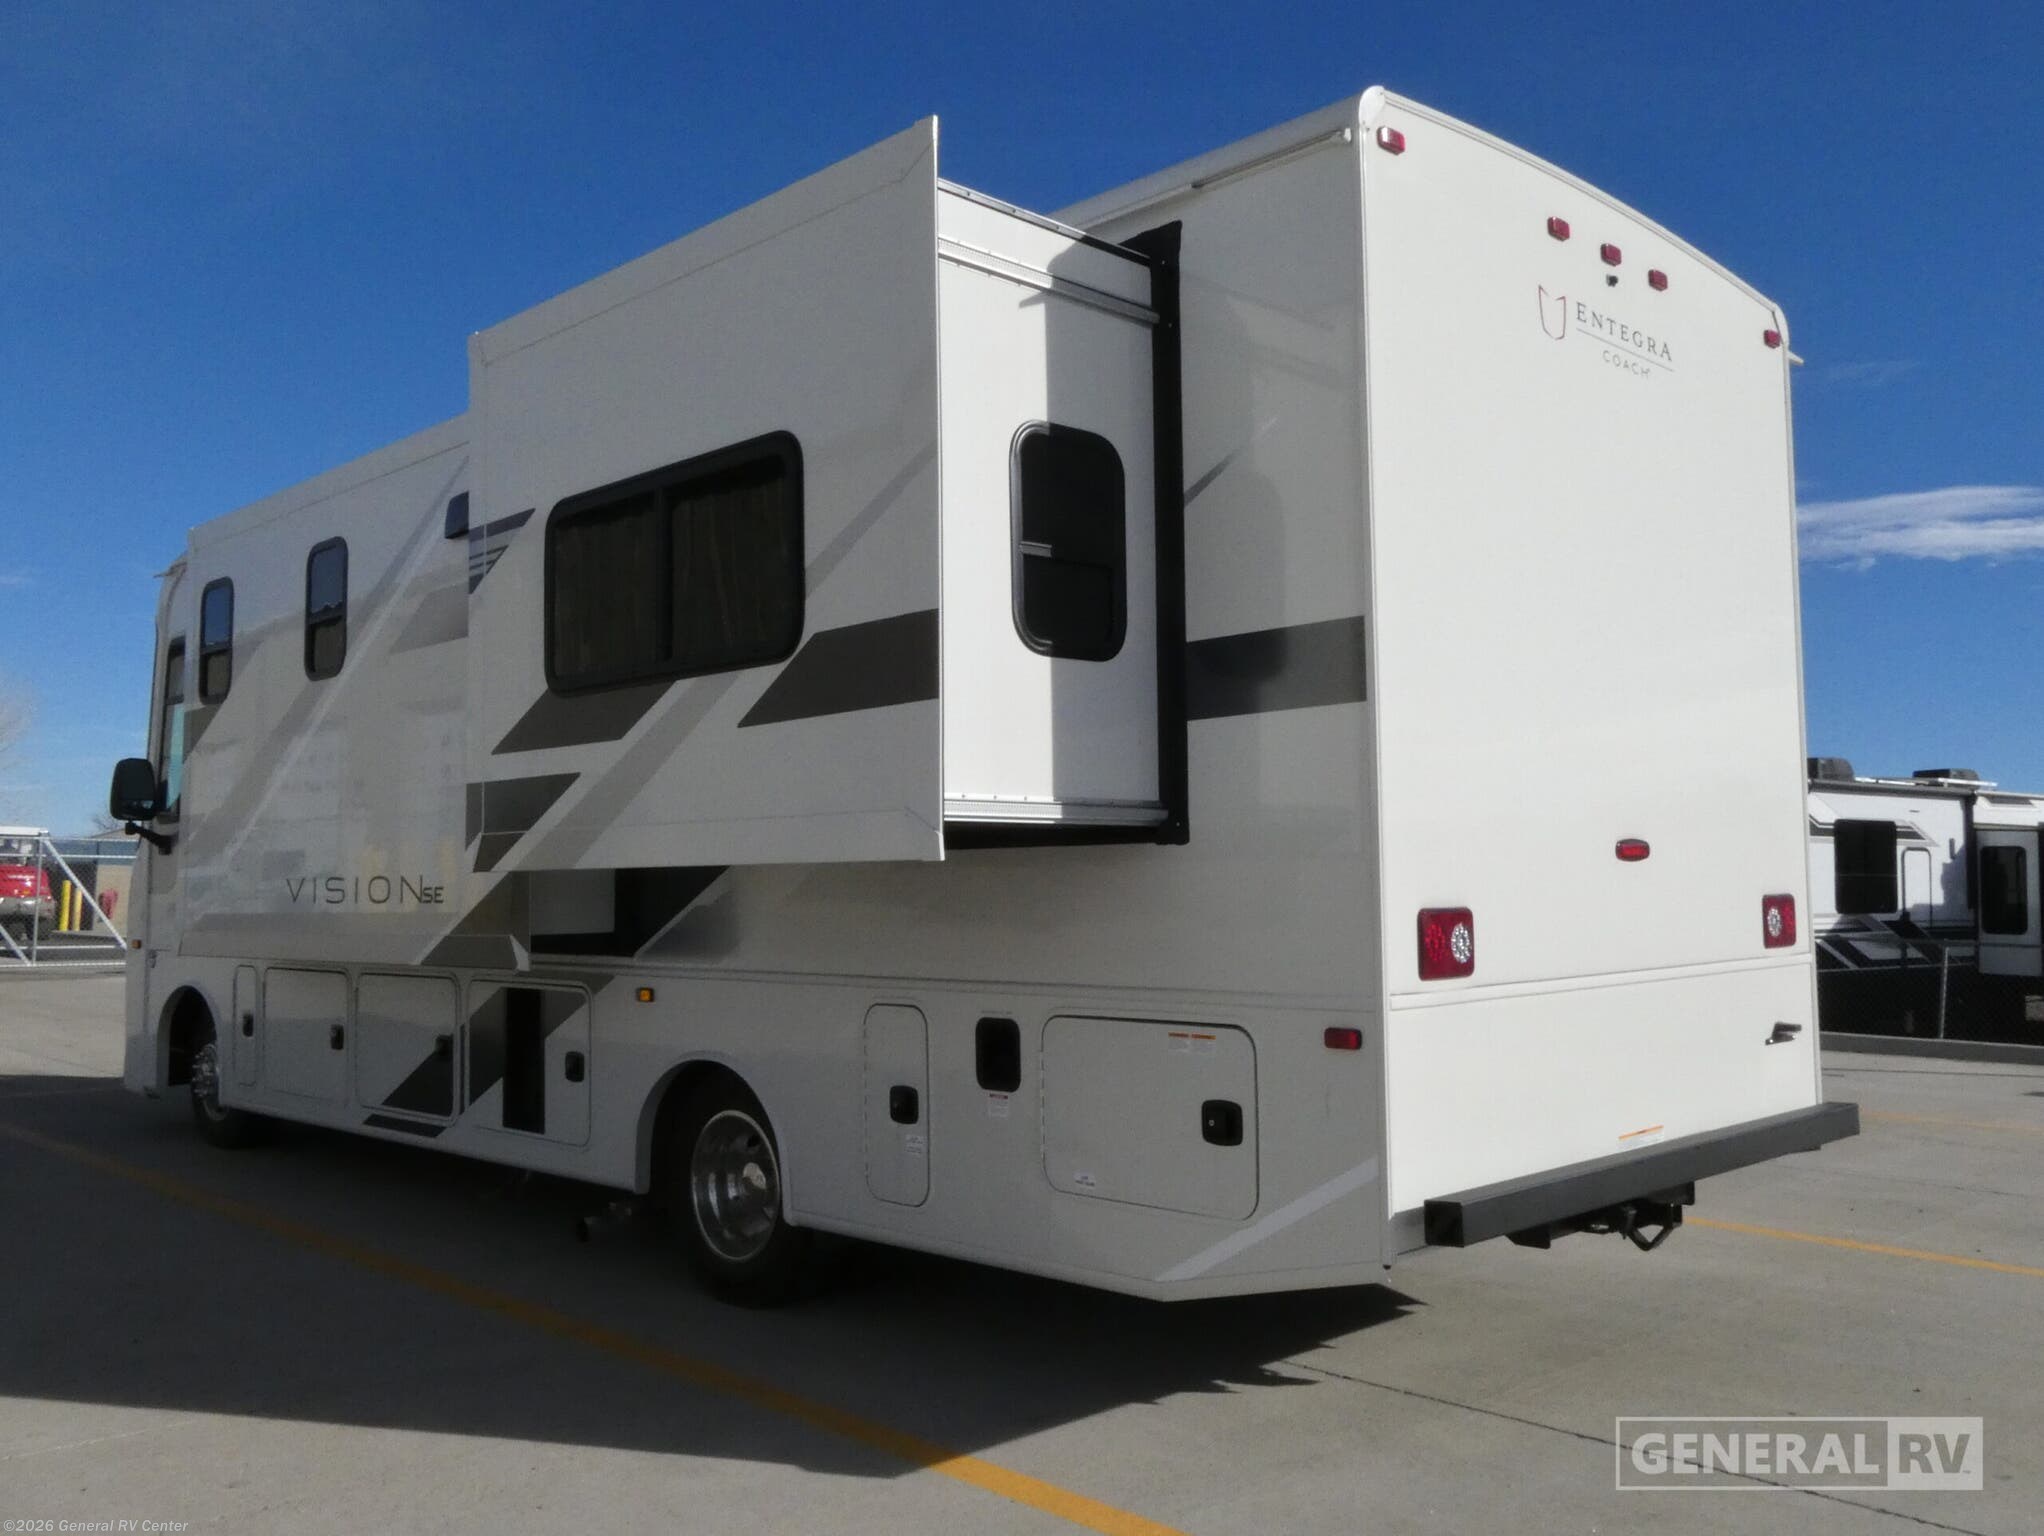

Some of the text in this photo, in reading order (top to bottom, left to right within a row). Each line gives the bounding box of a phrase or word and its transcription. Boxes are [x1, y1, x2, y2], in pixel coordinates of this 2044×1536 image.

[1576, 301, 1673, 362] ENTEGRA
[1602, 350, 1650, 376] COACH
[286, 874, 444, 904] VISION SE
